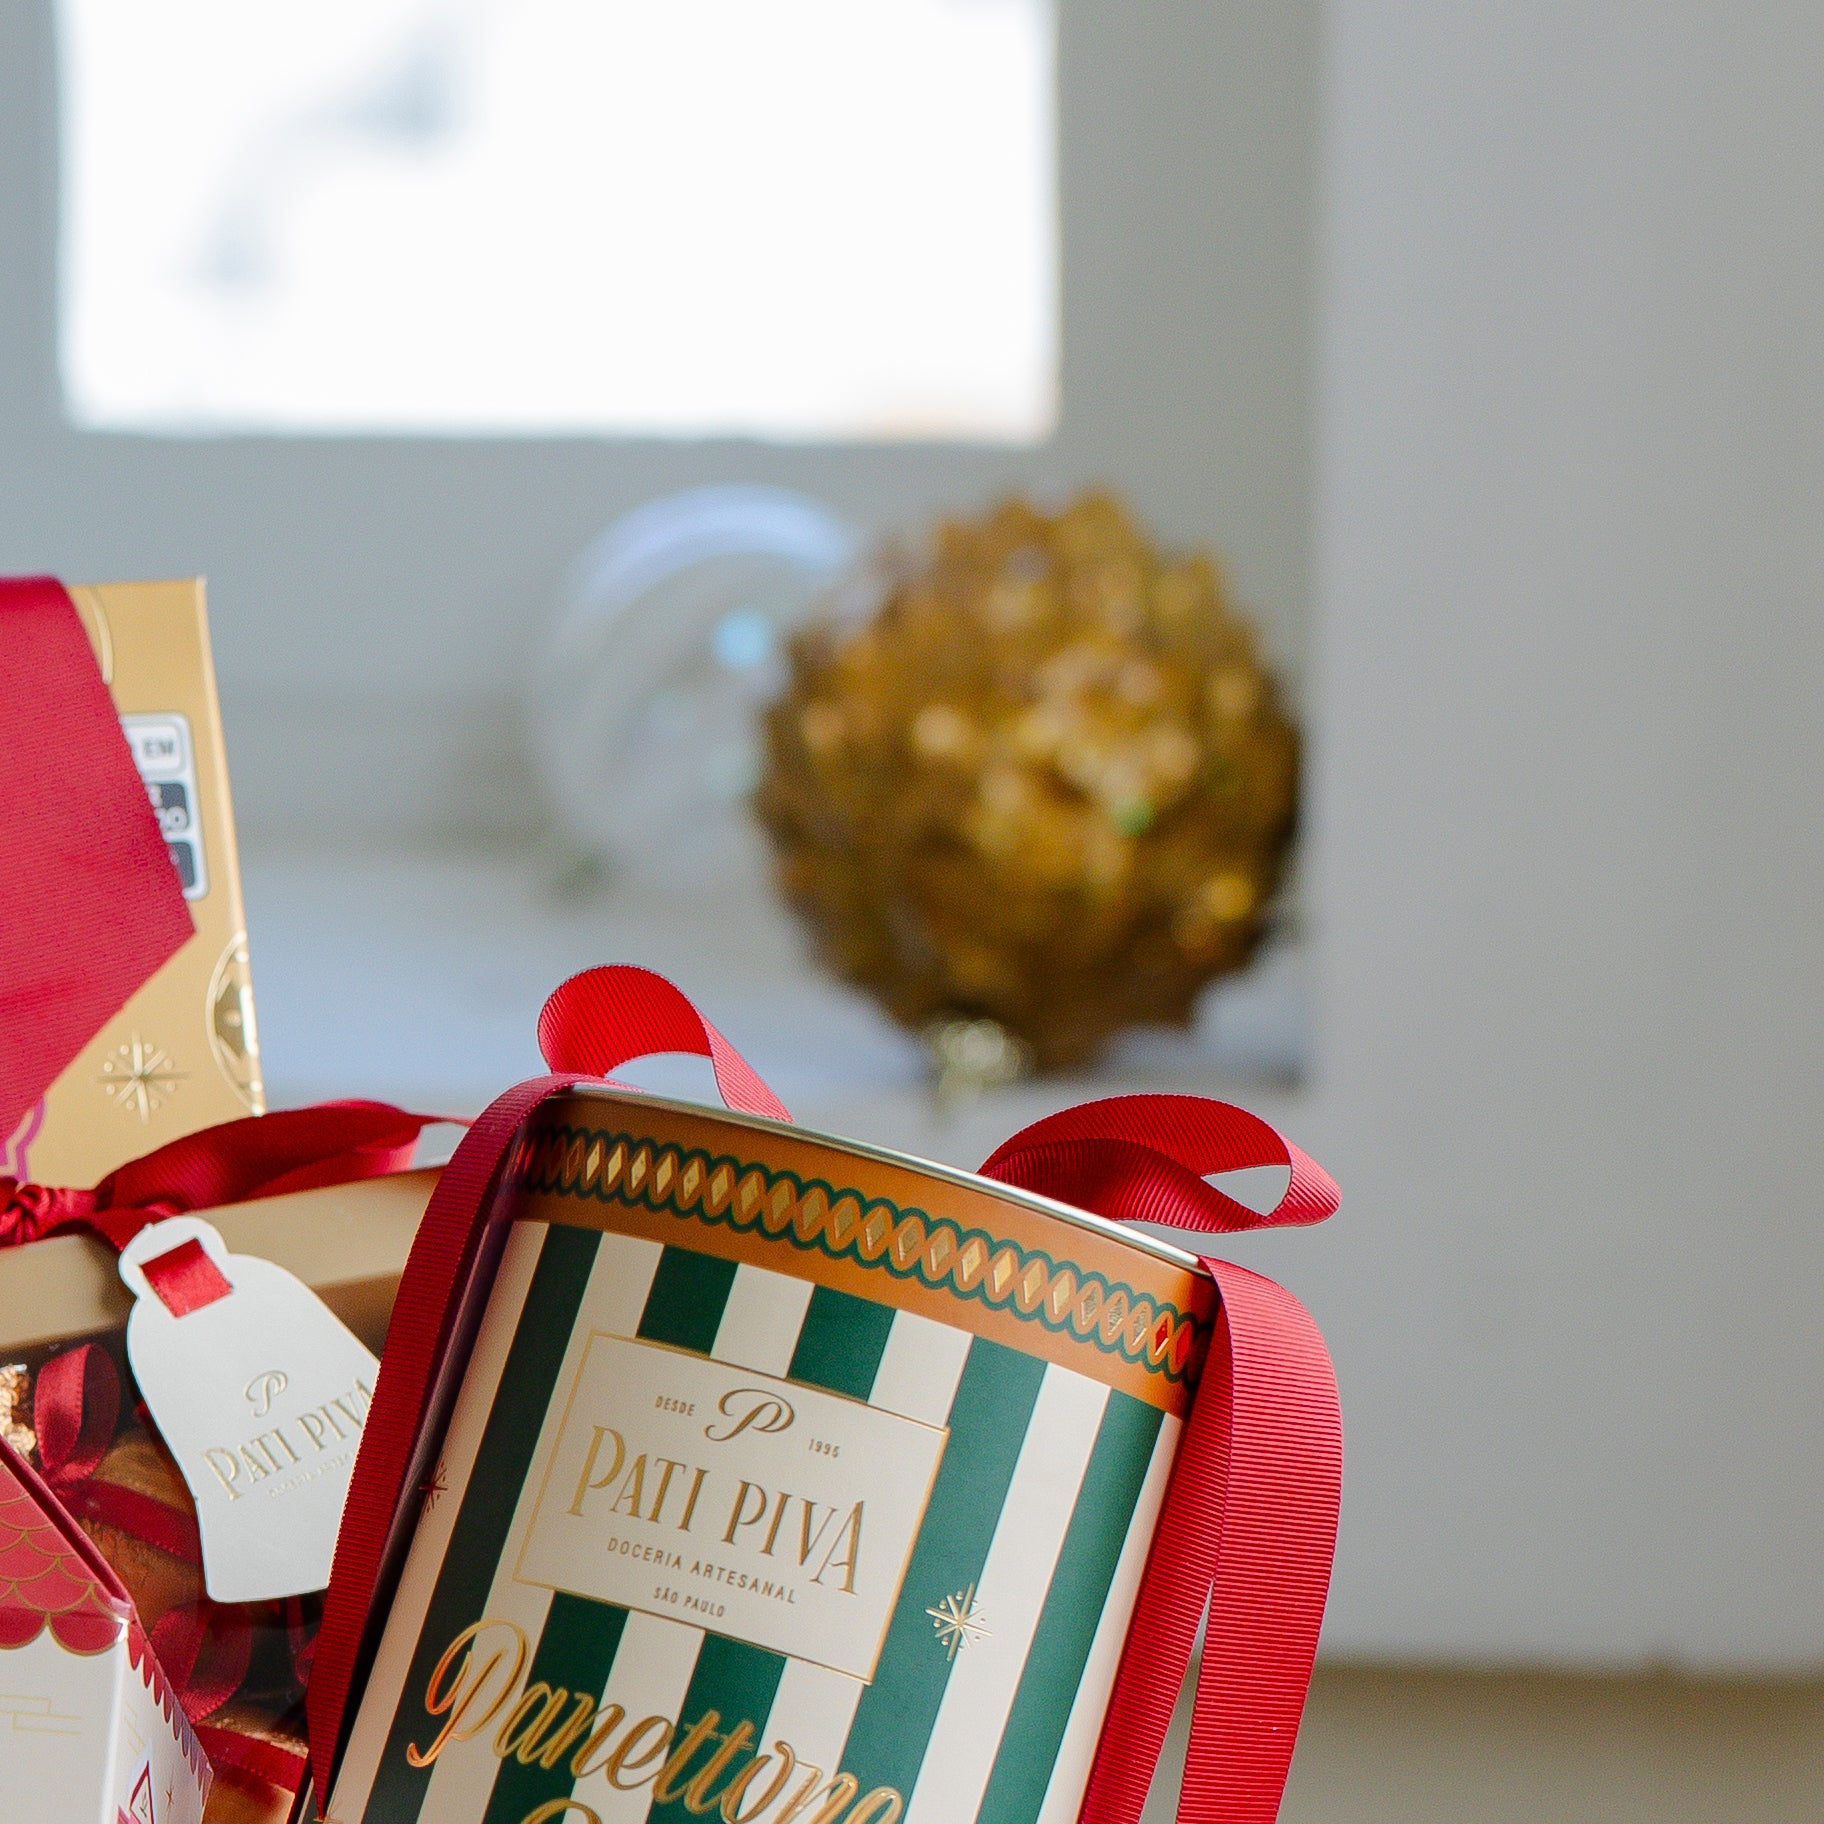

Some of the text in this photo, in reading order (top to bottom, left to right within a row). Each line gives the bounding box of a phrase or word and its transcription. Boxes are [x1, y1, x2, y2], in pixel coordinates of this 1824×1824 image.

[655, 1395, 695, 1416] DESDE
[202, 1428, 300, 1500] PATI
[567, 1425, 865, 1595] PATI PIVA
[607, 1537, 796, 1604] DOCERIA ARTESANAL
[653, 1587, 726, 1618] SÃO PAULO
